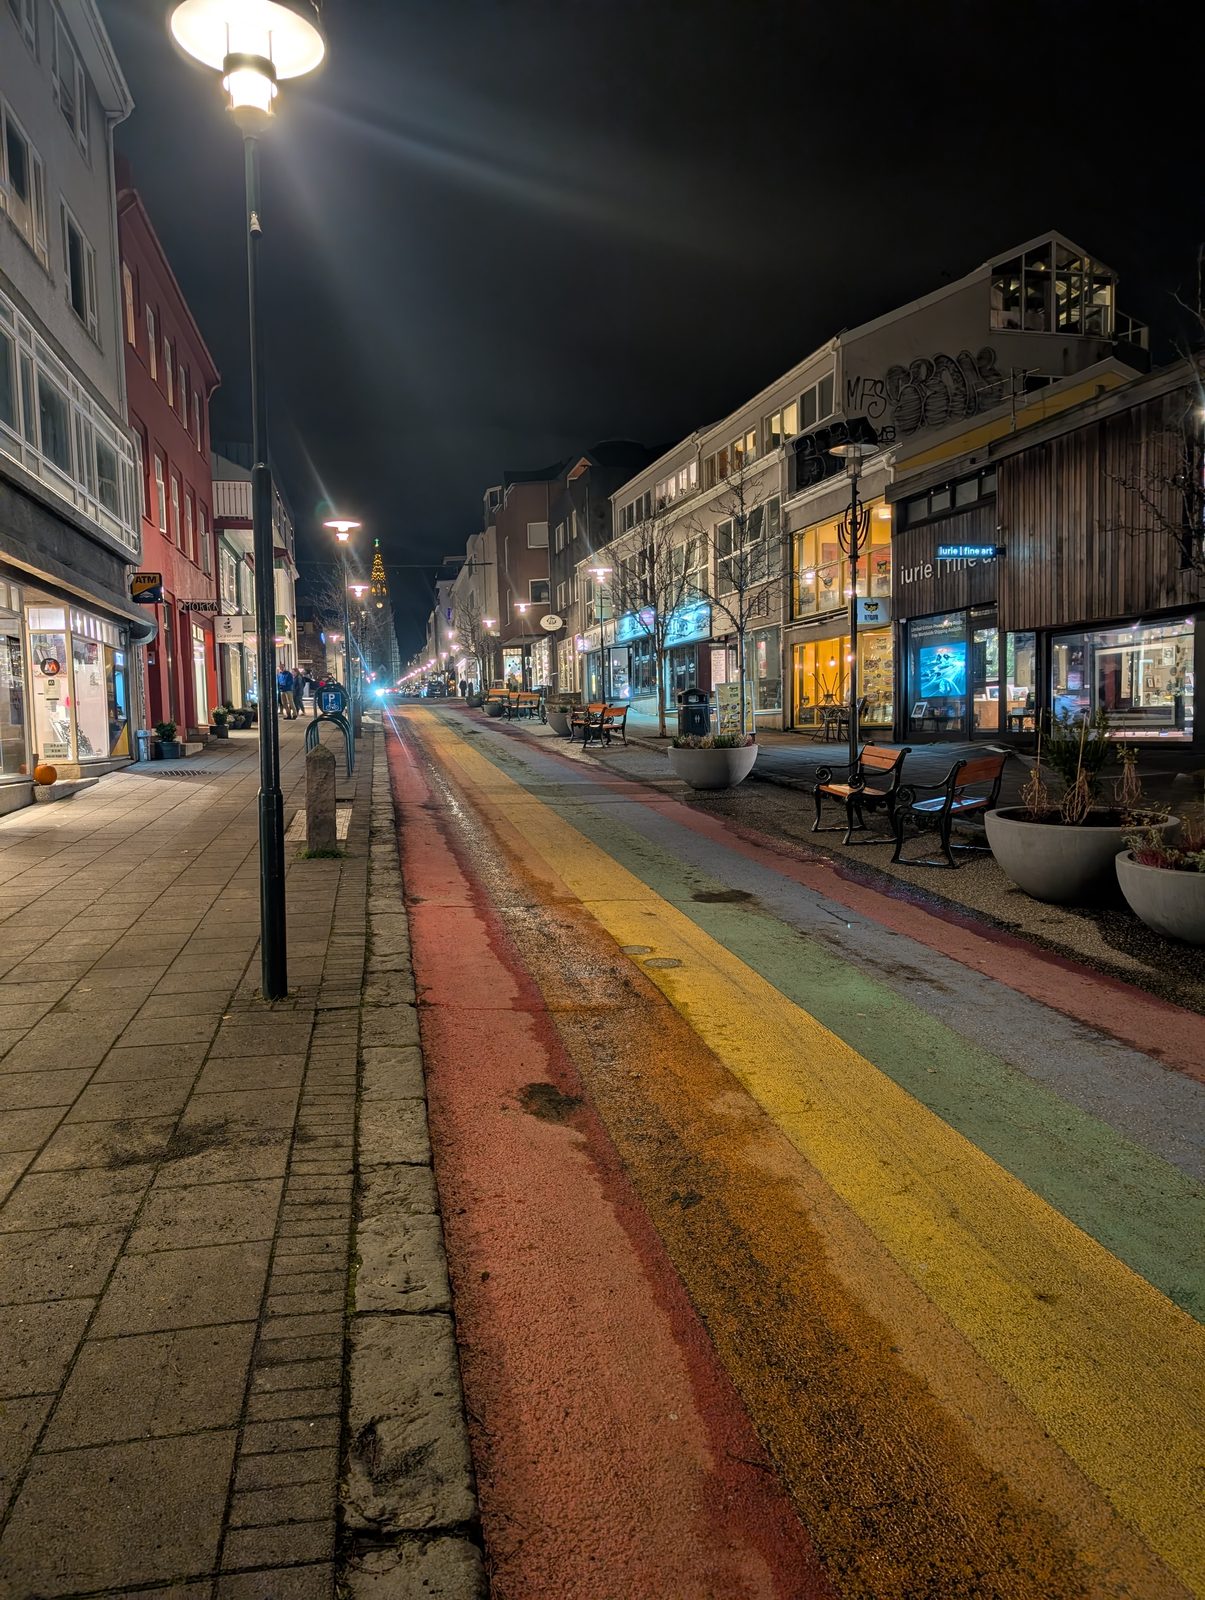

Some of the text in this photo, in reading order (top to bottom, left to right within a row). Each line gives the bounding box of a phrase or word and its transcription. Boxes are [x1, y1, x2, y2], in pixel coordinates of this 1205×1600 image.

[847, 376, 887, 419] MFS
[939, 546, 958, 555] iurie
[964, 546, 979, 555] fine
[981, 547, 993, 555] art
[901, 560, 932, 584] iurie
[183, 601, 219, 611] MOKKA
[328, 694, 335, 702] P
